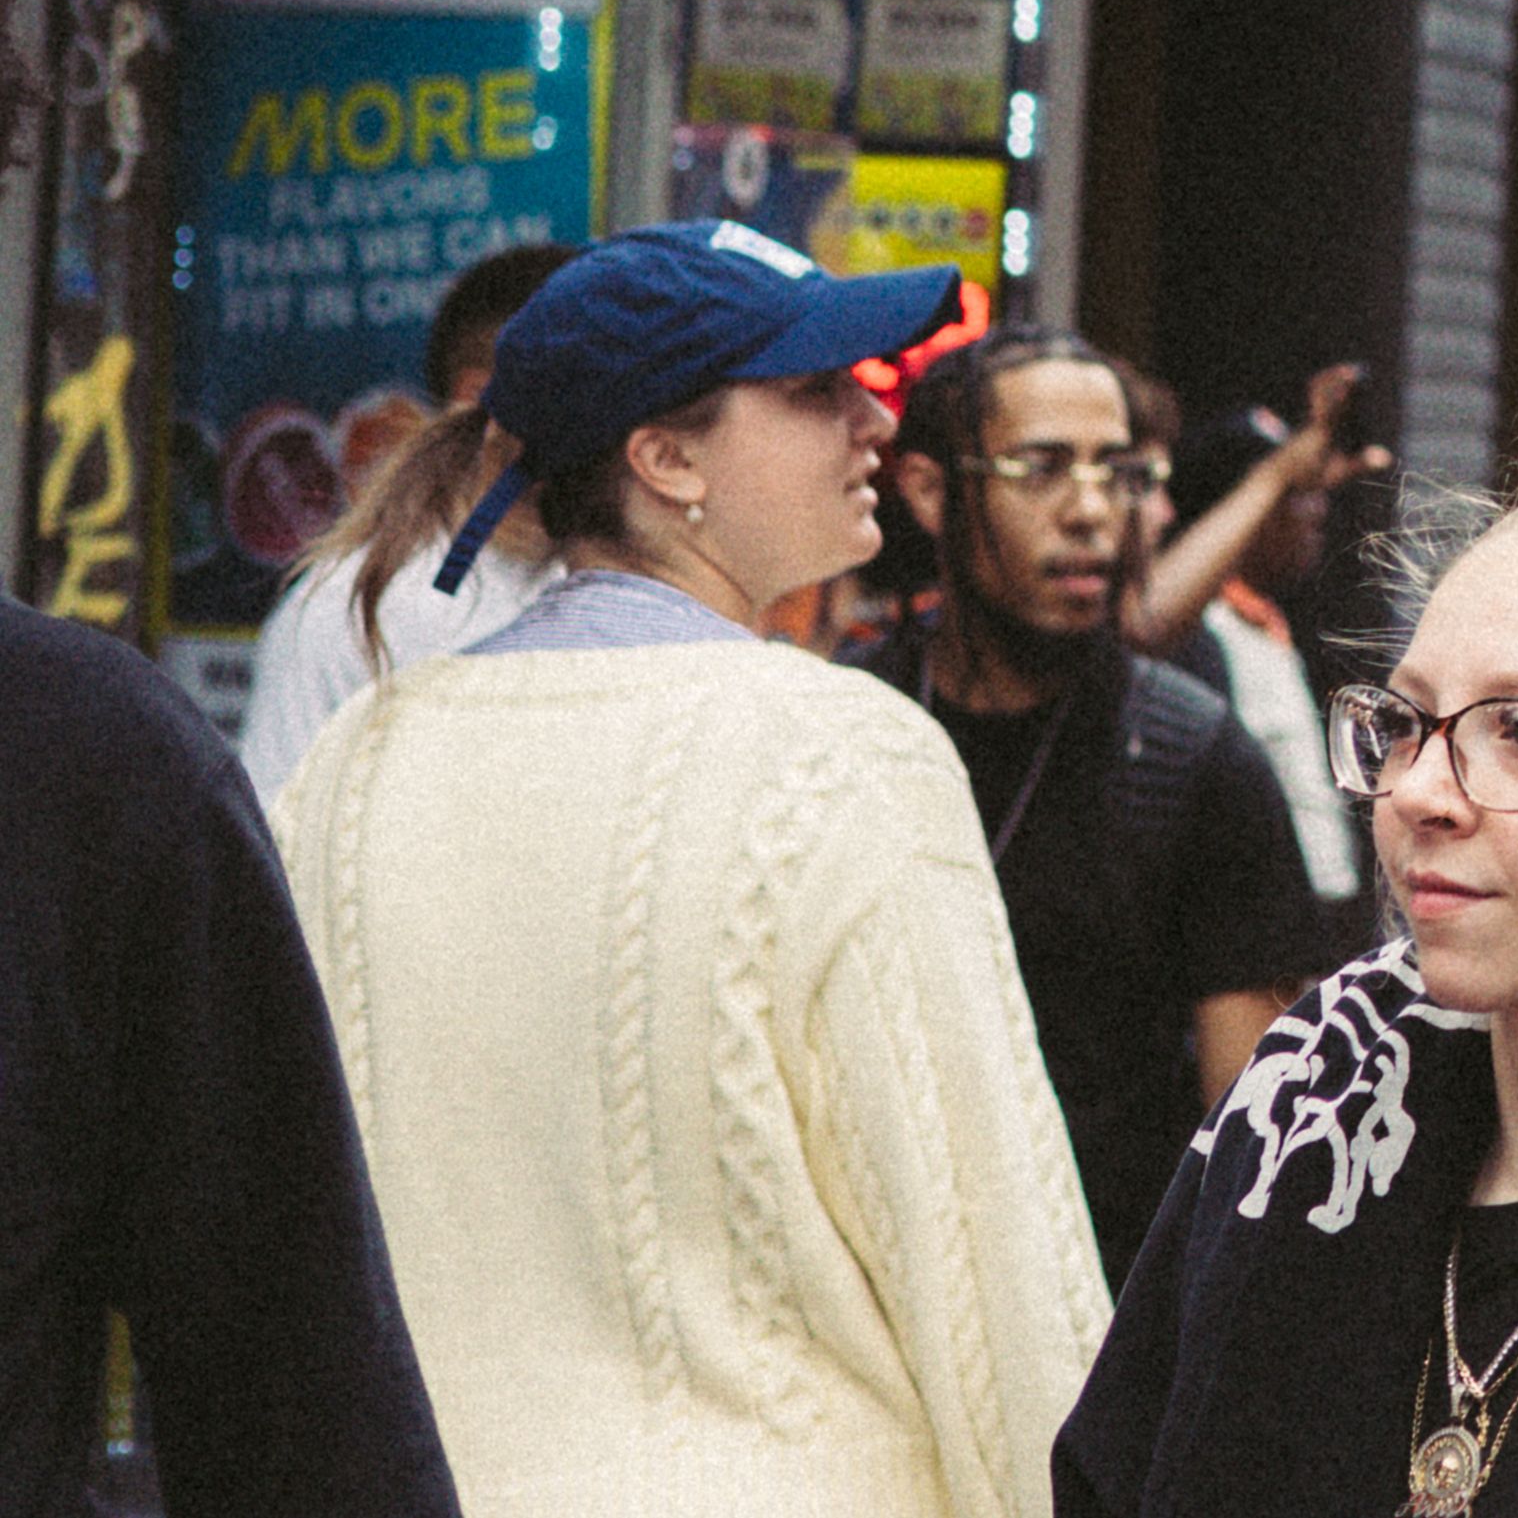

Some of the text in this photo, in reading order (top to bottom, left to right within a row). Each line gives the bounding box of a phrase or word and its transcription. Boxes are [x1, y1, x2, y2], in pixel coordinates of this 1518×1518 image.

[227, 70, 538, 179] MORE
[217, 232, 349, 279] THAN
[361, 270, 458, 326] ON
